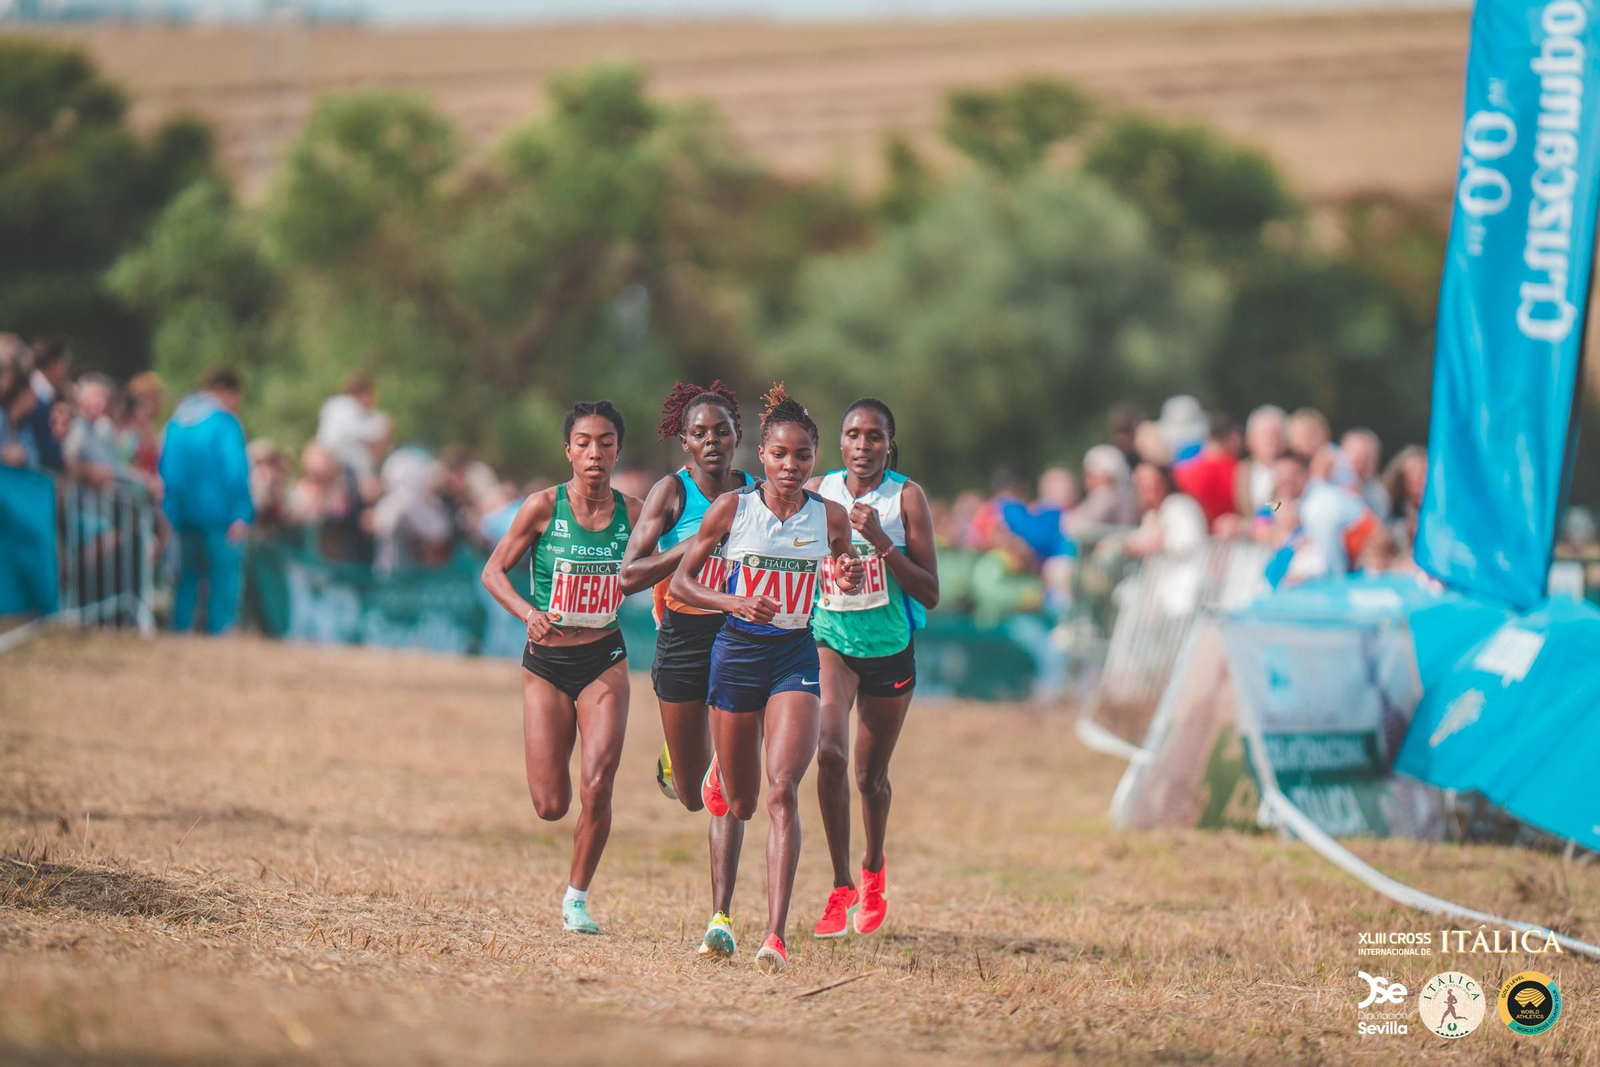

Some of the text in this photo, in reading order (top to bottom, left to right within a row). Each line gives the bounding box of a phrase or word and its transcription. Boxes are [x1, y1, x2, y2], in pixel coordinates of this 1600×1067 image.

[571, 545, 612, 556] Facsa
[576, 563, 611, 573] ITÁLICA
[764, 558, 800, 570] ITÁLICA
[742, 566, 815, 614] YAVI
